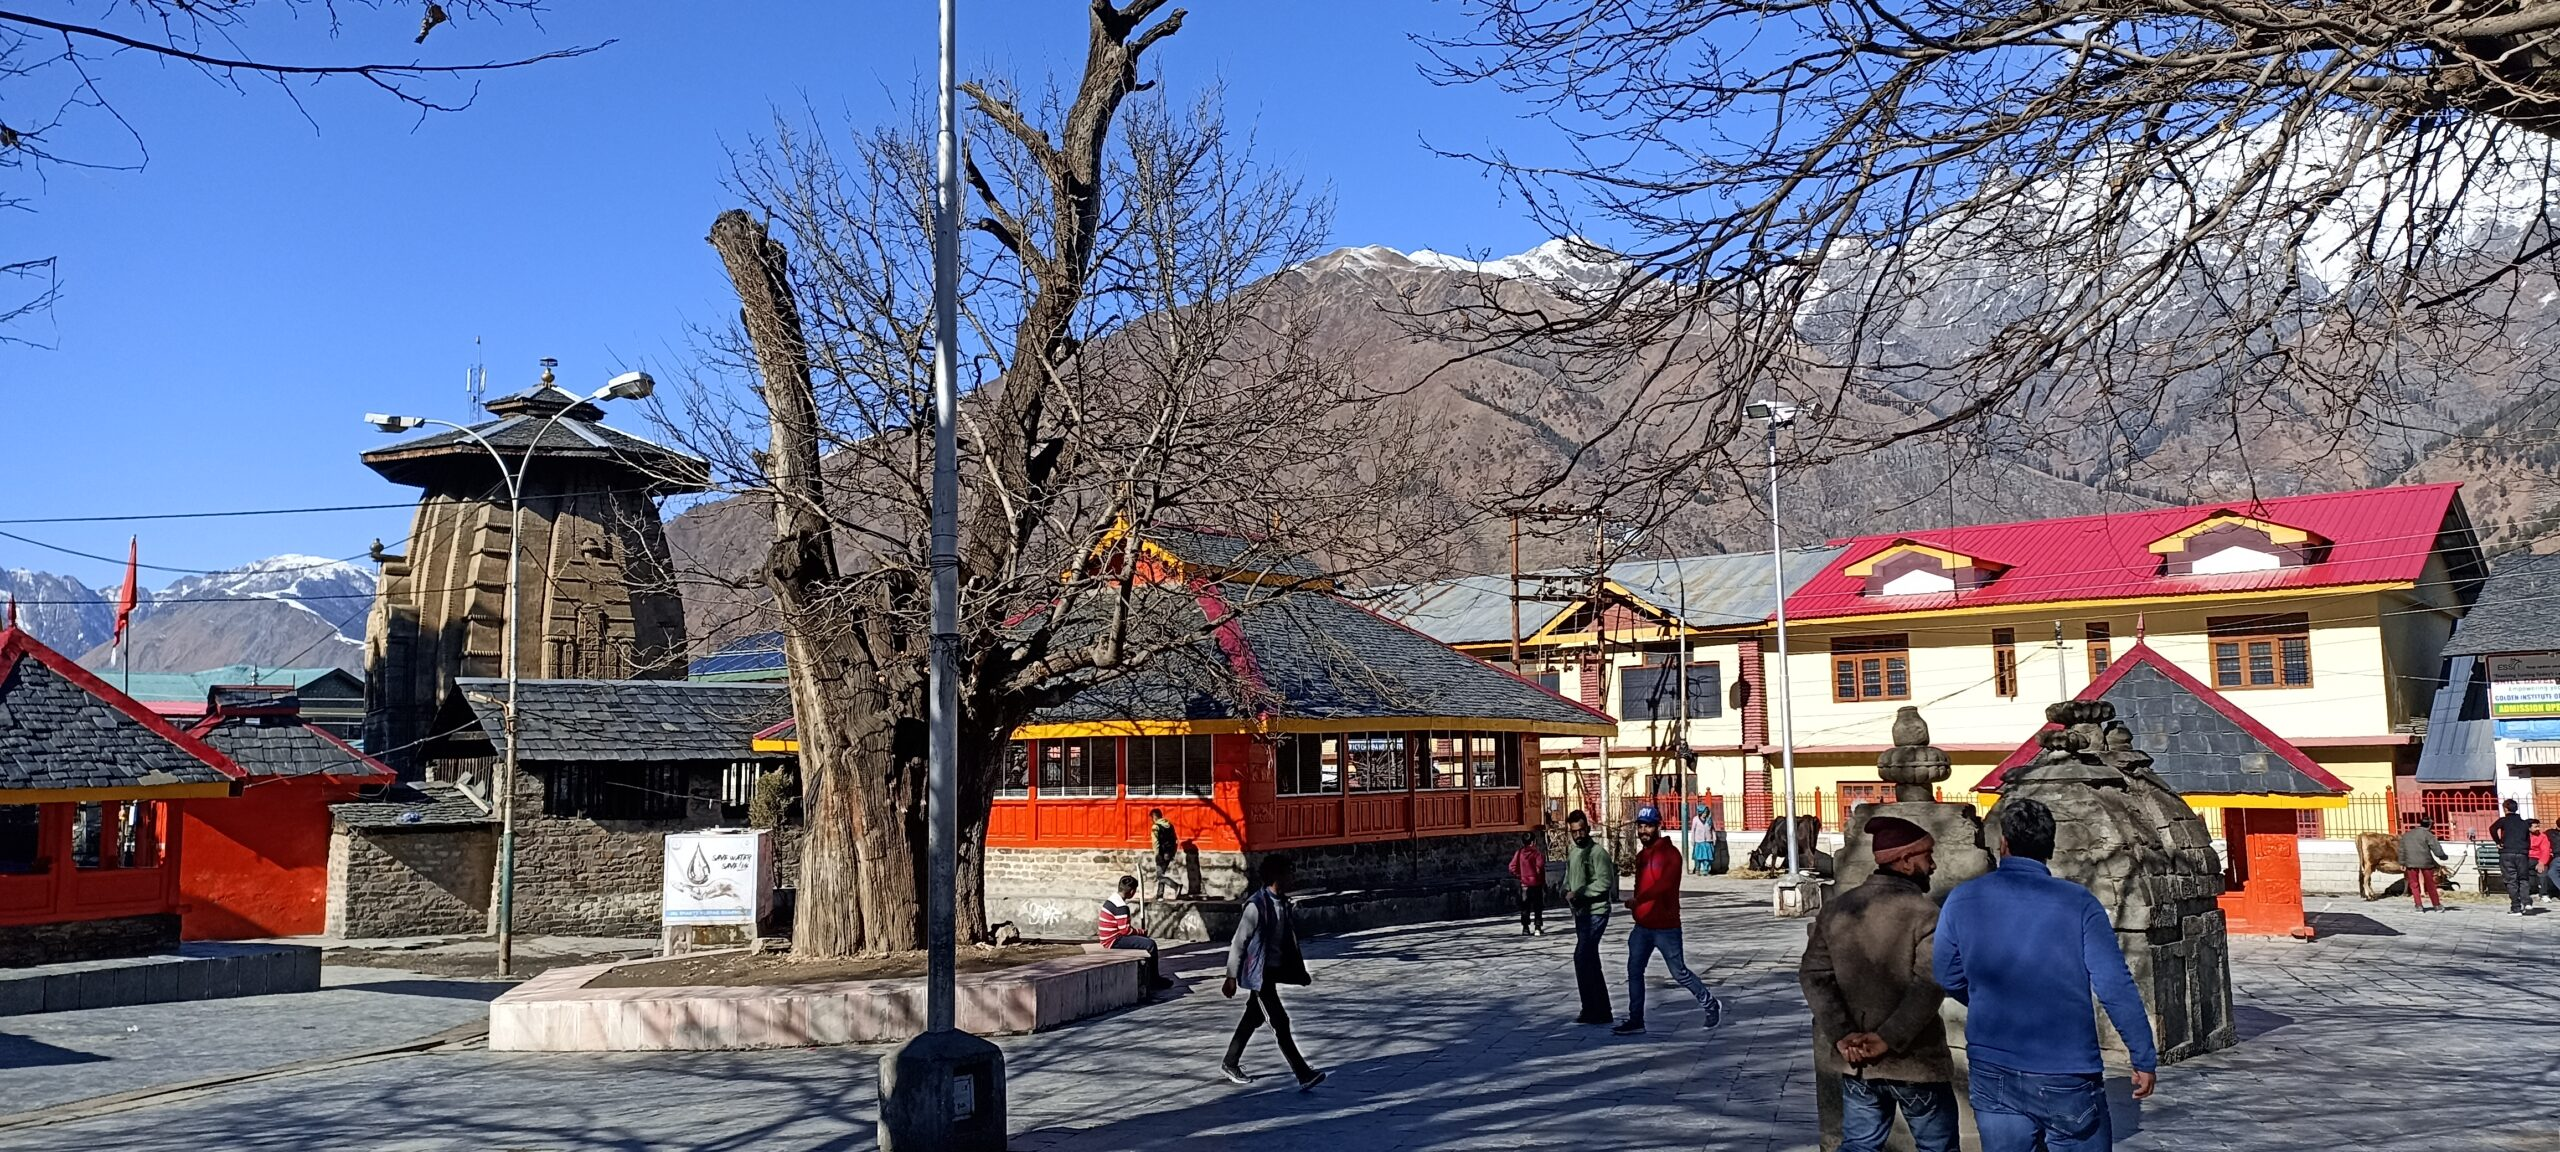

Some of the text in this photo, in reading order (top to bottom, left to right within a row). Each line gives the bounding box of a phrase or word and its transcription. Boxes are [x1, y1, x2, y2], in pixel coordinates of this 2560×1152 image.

[2498, 703, 2544, 713] ADMISSION
[730, 854, 752, 862] WATER
[722, 862, 738, 870] SAVE
